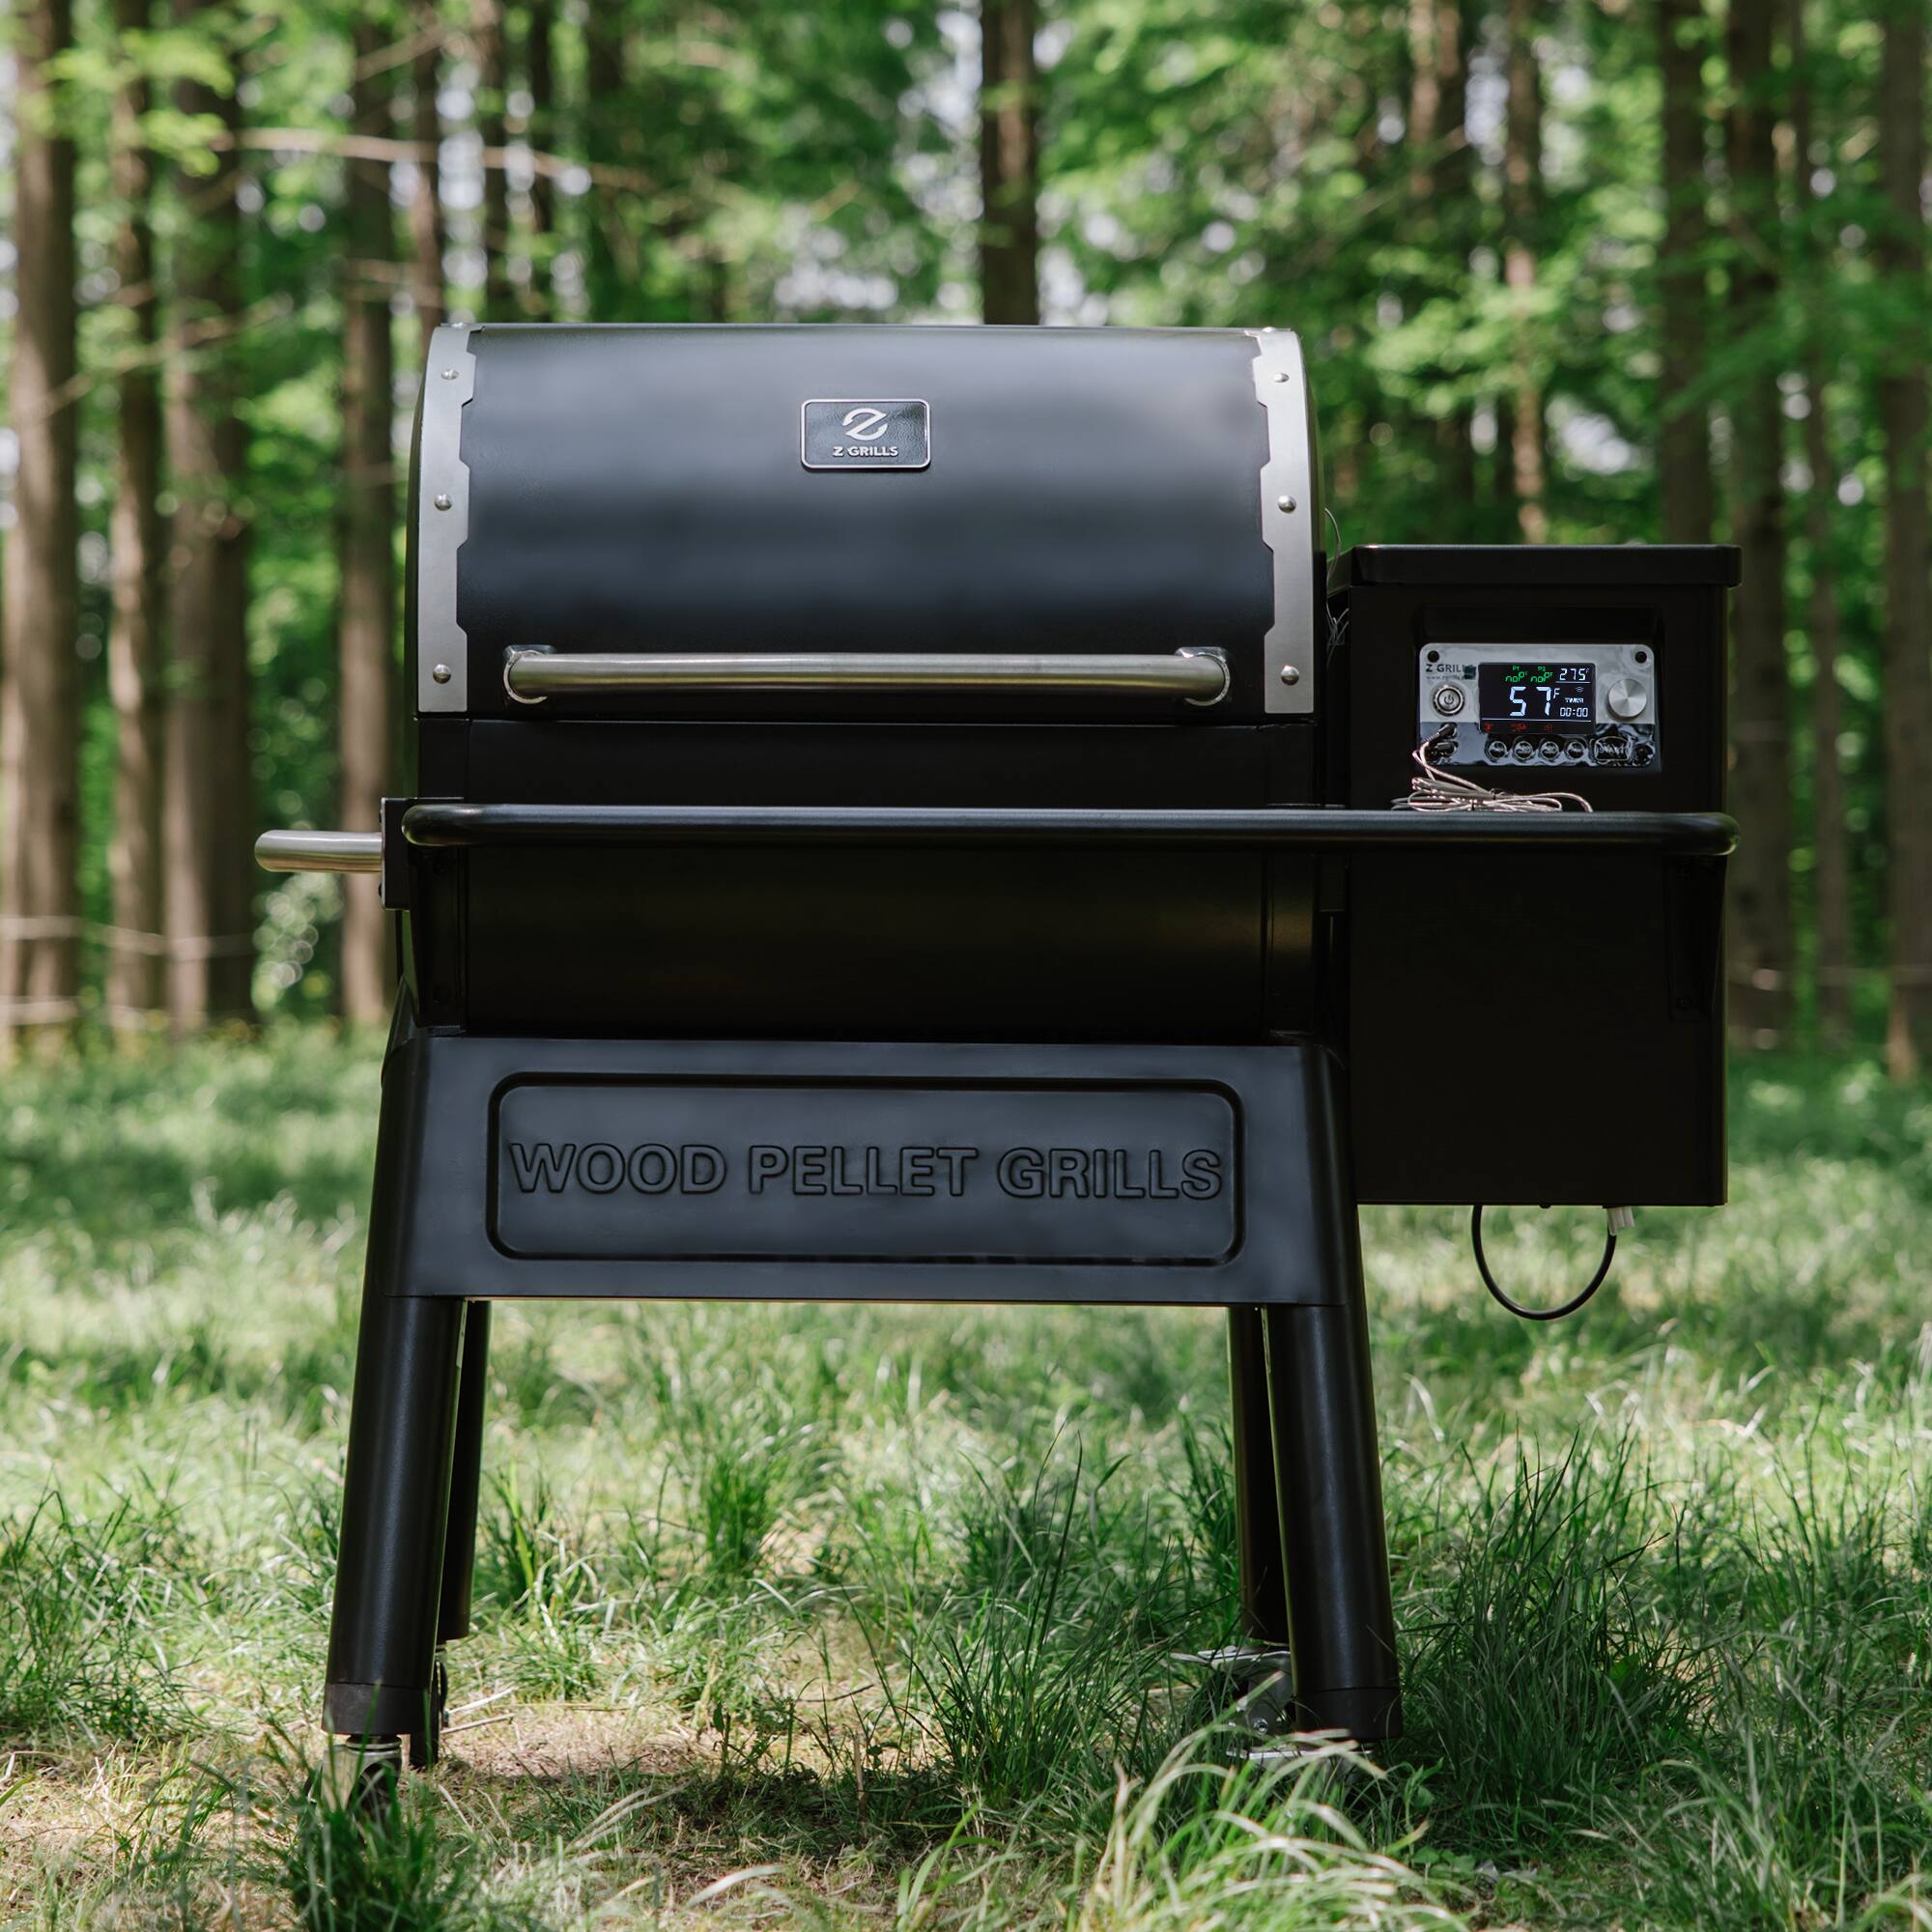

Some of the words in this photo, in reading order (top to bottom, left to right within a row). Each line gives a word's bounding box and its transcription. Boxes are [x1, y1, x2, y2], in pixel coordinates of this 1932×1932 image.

[833, 446, 843, 456] Z
[847, 446, 898, 456] GRILLS
[1426, 664, 1433, 672] Z
[1559, 707, 1589, 717] 00:00
[510, 1143, 725, 1194] WOOD
[749, 1145, 979, 1197] PELLET
[997, 1147, 1222, 1200] GRILLS
